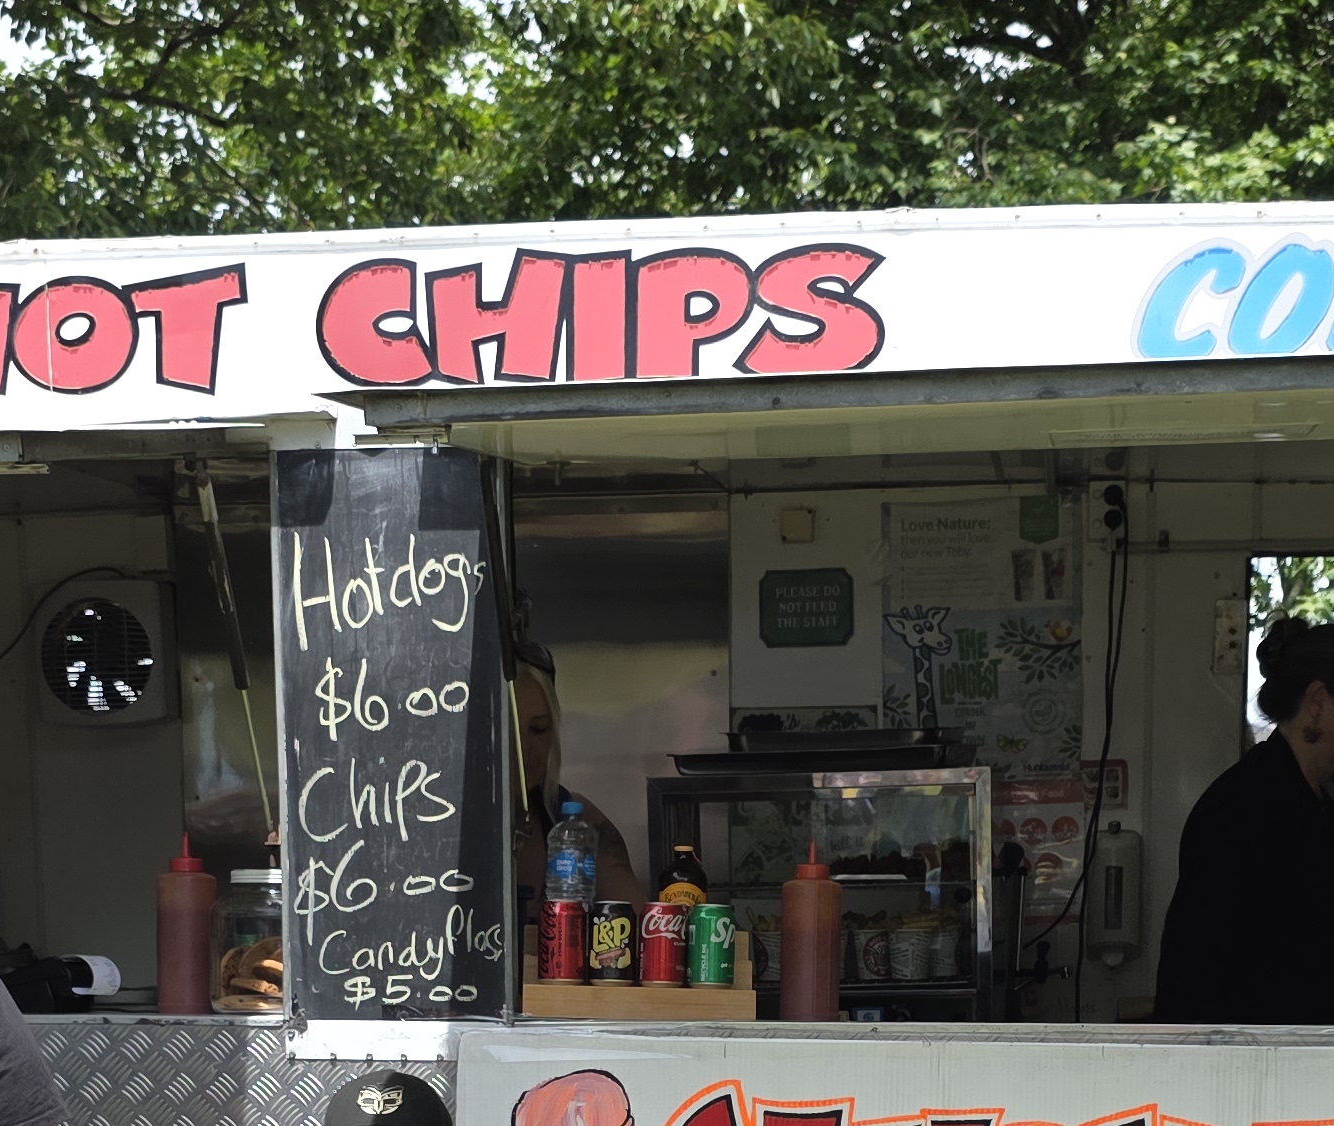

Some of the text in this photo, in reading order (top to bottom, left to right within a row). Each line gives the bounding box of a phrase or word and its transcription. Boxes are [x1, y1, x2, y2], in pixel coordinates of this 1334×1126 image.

[315, 242, 886, 385] CHIPS
[901, 518, 991, 532] Love Nature;
[900, 533, 991, 547] then you will love
[901, 550, 919, 560] our
[921, 549, 943, 558] new
[776, 585, 841, 598] PLEASE DO
[779, 600, 837, 613] NOT FEED
[776, 616, 840, 628] THE STAFF
[954, 628, 989, 661] THE
[938, 658, 1003, 705] LONGEST
[954, 706, 986, 718] DRINK
[293, 839, 474, 947] $6.00
[592, 915, 632, 953] L&P
[700, 951, 708, 981] RECYCLE
[344, 975, 479, 1012] $5.00
